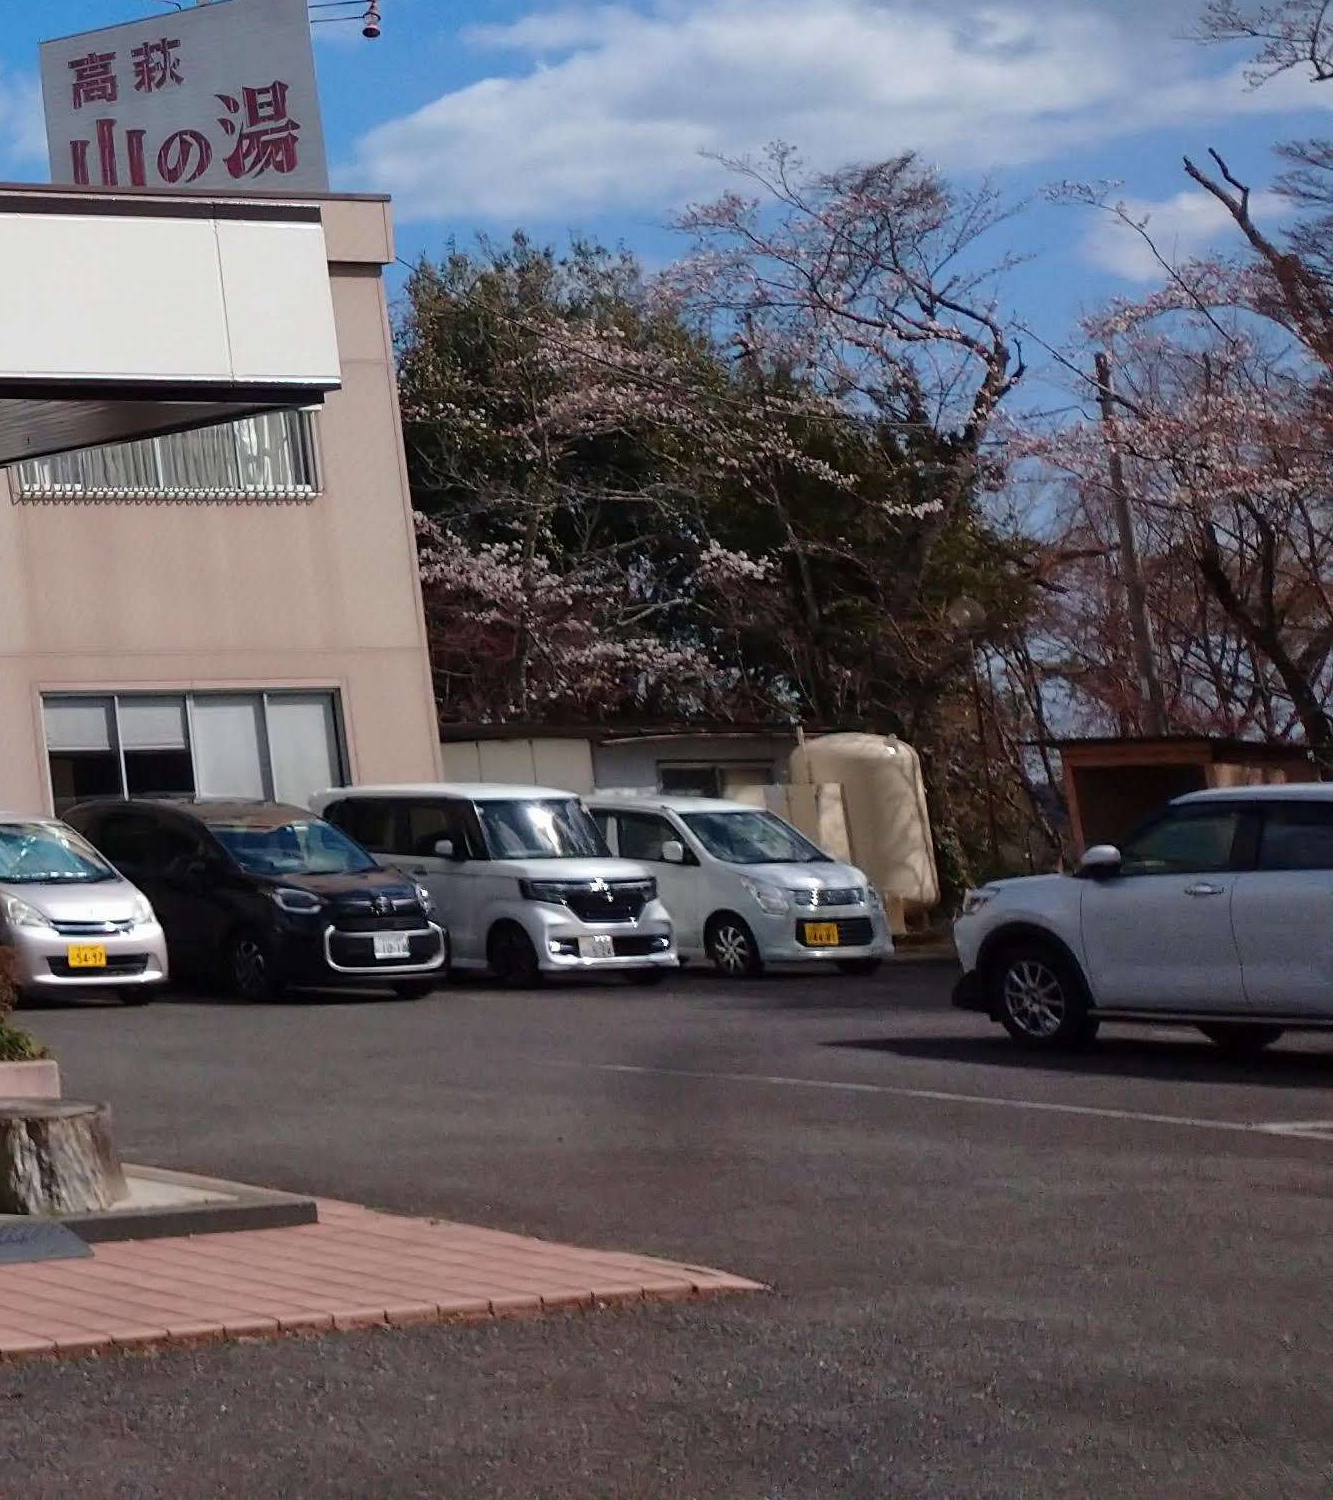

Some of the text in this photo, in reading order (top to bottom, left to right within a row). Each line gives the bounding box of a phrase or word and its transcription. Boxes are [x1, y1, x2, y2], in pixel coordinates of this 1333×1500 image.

[67, 37, 185, 110] 高萩
[69, 80, 301, 187] 山の湯
